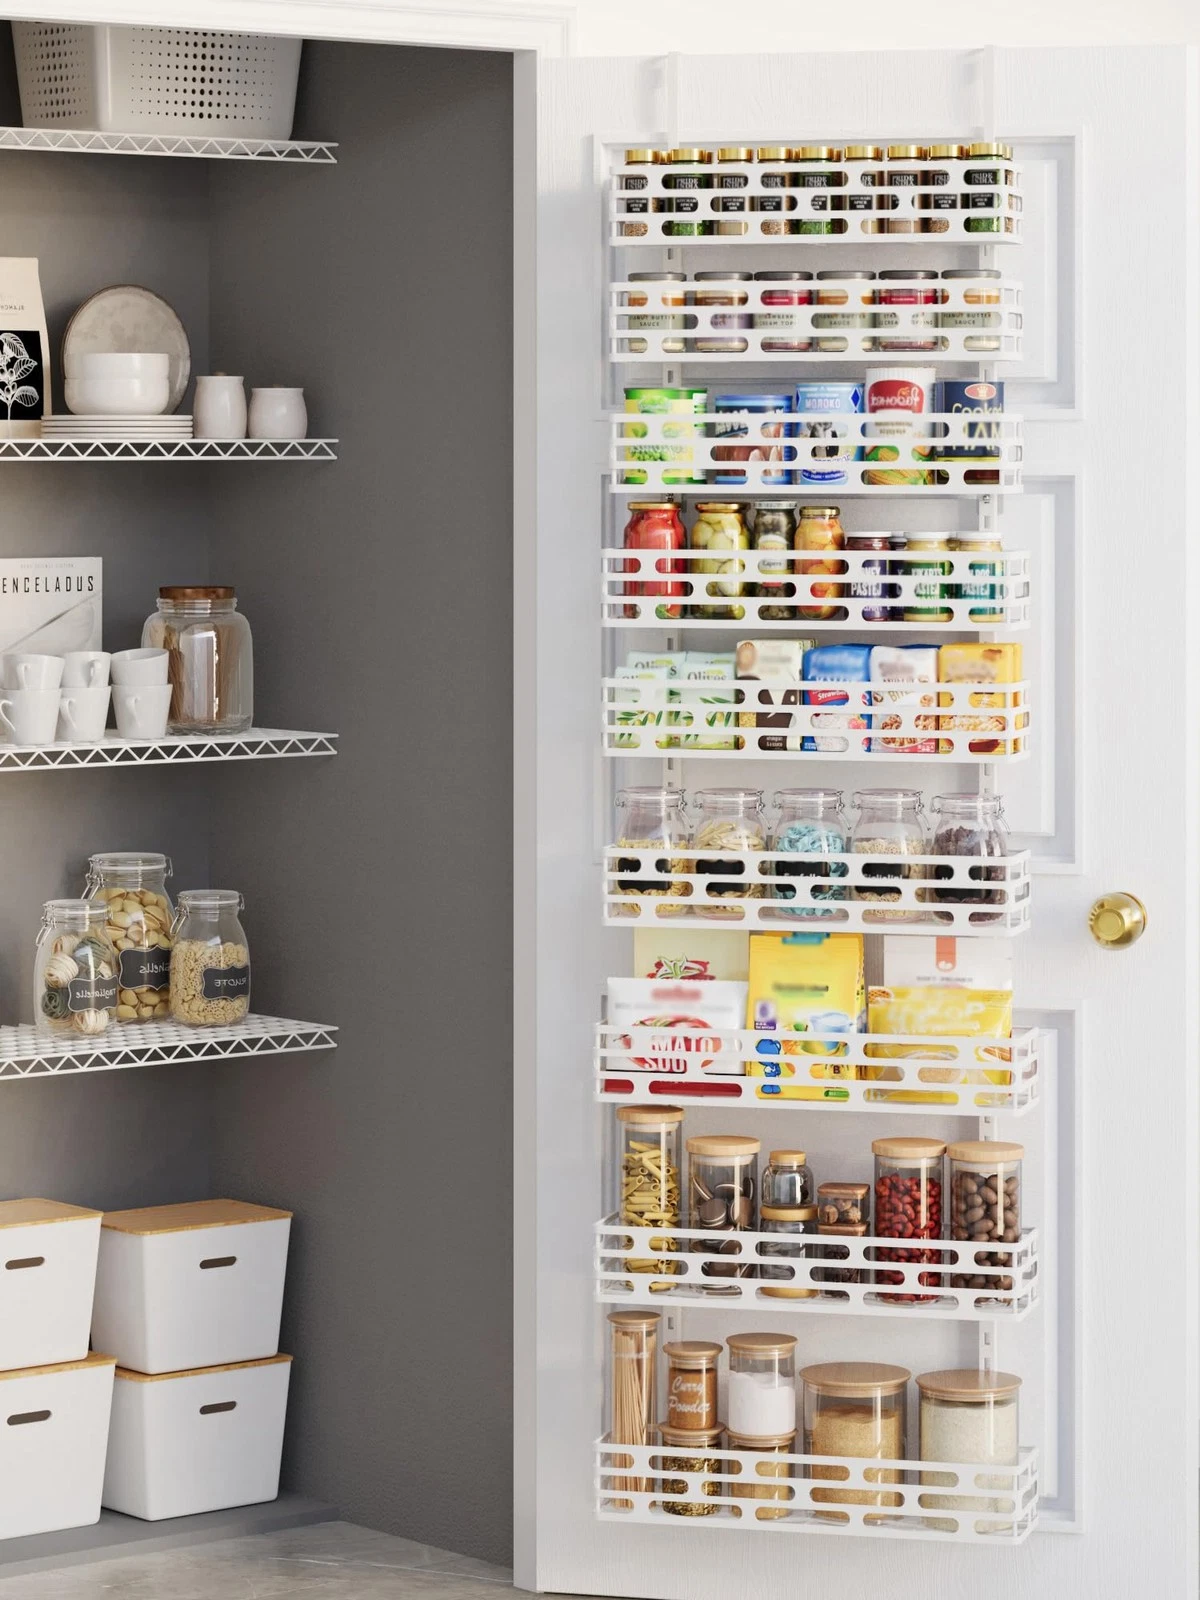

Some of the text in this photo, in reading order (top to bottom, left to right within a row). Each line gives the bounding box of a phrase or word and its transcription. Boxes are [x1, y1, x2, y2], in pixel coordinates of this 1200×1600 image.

[2, 576, 94, 594] ENCELADUS
[671, 1376, 705, 1396] Curry
[668, 1396, 711, 1413] Powder
